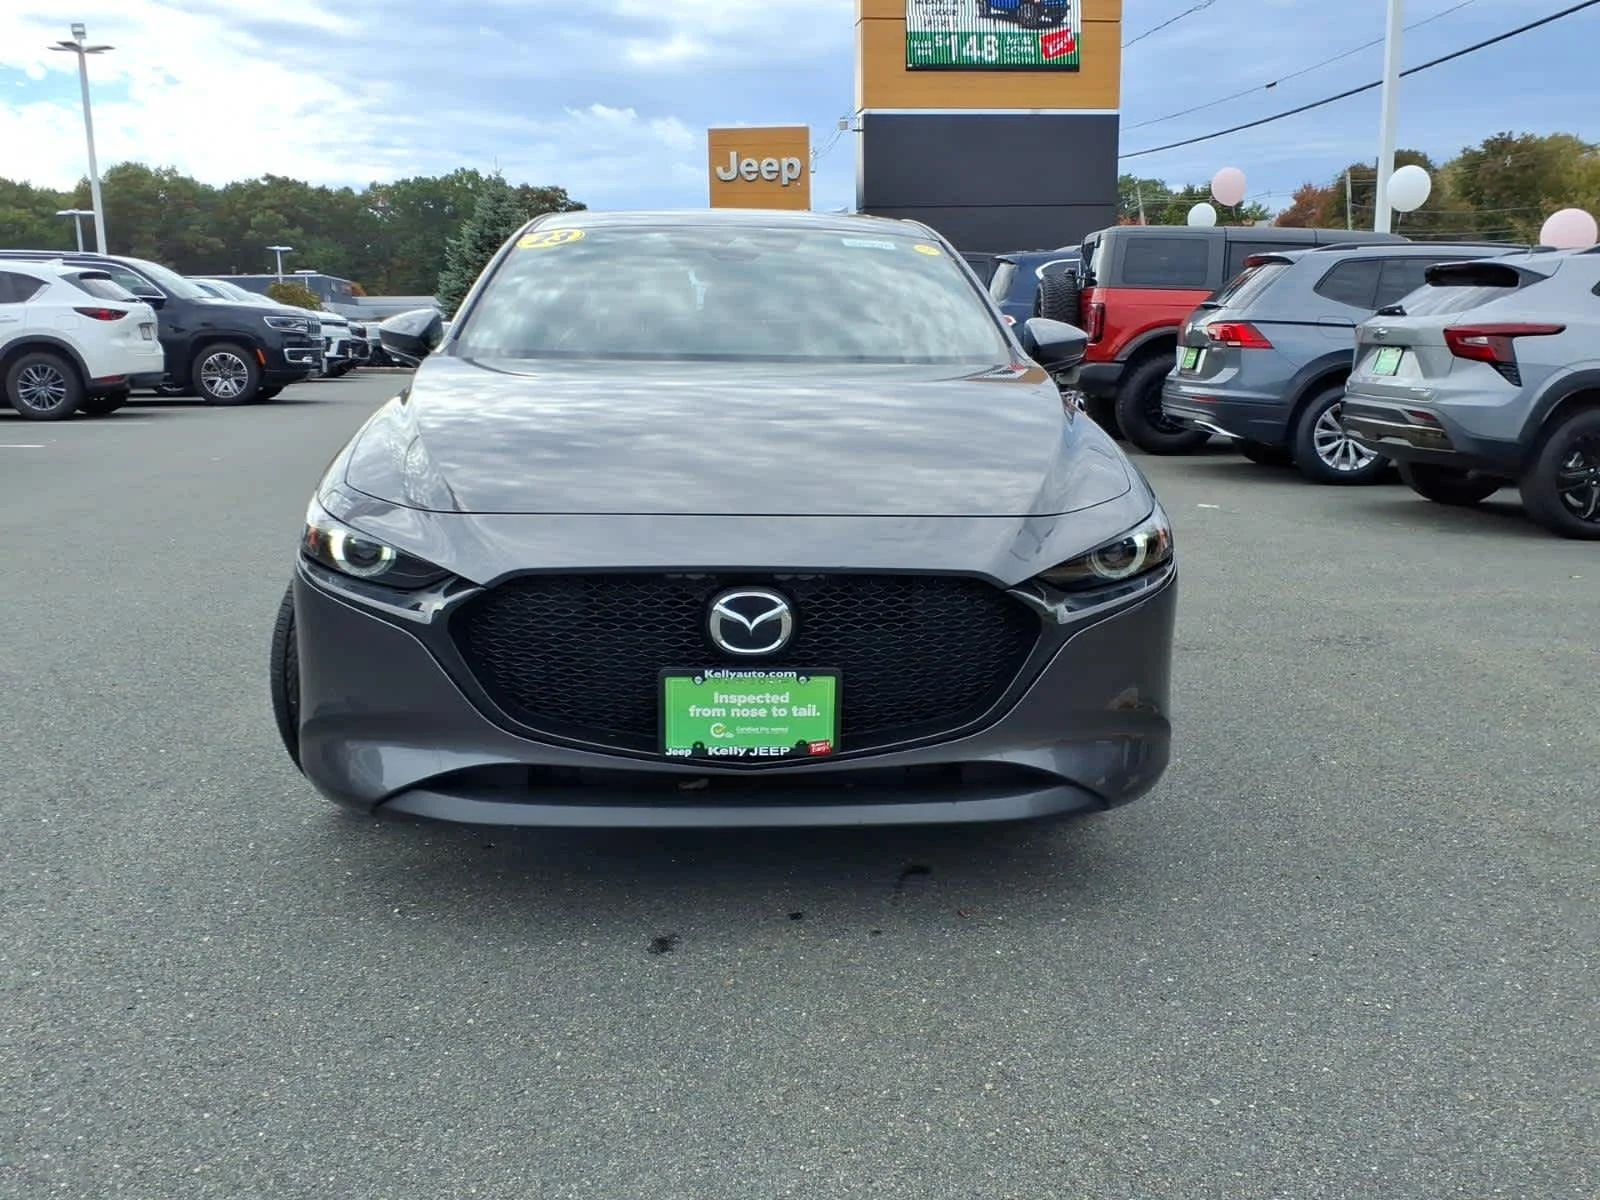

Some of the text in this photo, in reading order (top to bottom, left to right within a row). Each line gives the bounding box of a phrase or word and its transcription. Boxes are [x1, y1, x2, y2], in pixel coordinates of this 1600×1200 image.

[716, 151, 801, 185] Jeep
[704, 669, 797, 680] Kellyauto.com
[713, 692, 790, 706] Inspected
[688, 705, 820, 717] from nose to tail.
[665, 747, 692, 757] Jeep
[707, 746, 791, 757] Kelly JEEP
